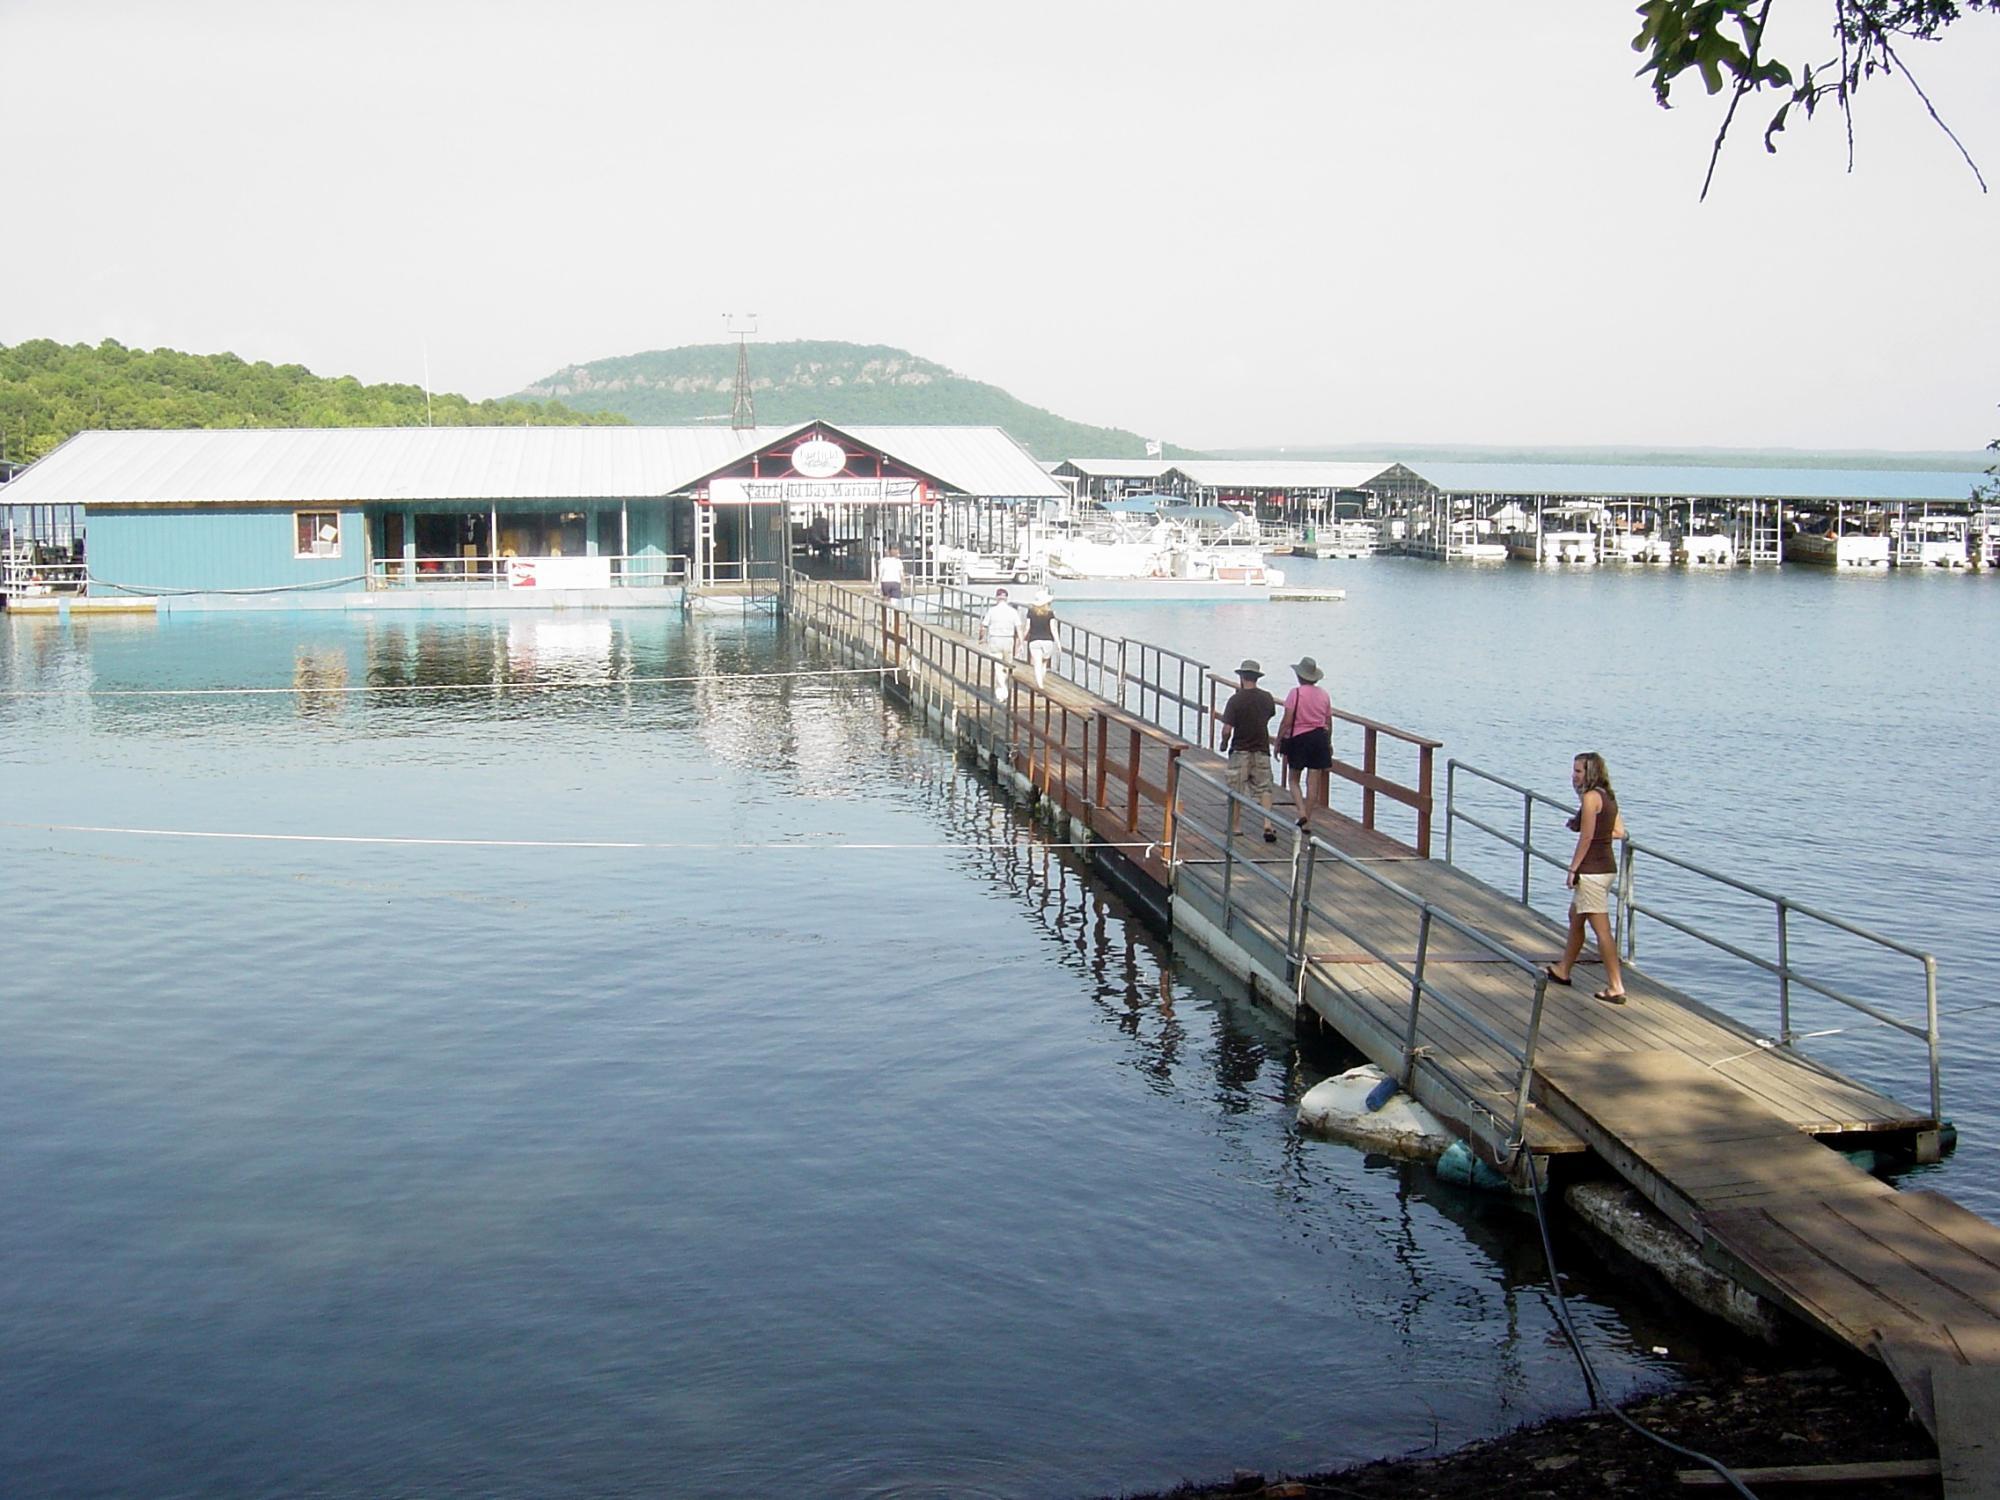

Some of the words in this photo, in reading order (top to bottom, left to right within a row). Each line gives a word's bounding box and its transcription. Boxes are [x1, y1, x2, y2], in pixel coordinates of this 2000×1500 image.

[747, 482, 801, 497] Fairfld
[805, 482, 826, 499] Bay
[828, 482, 879, 497] Marina
